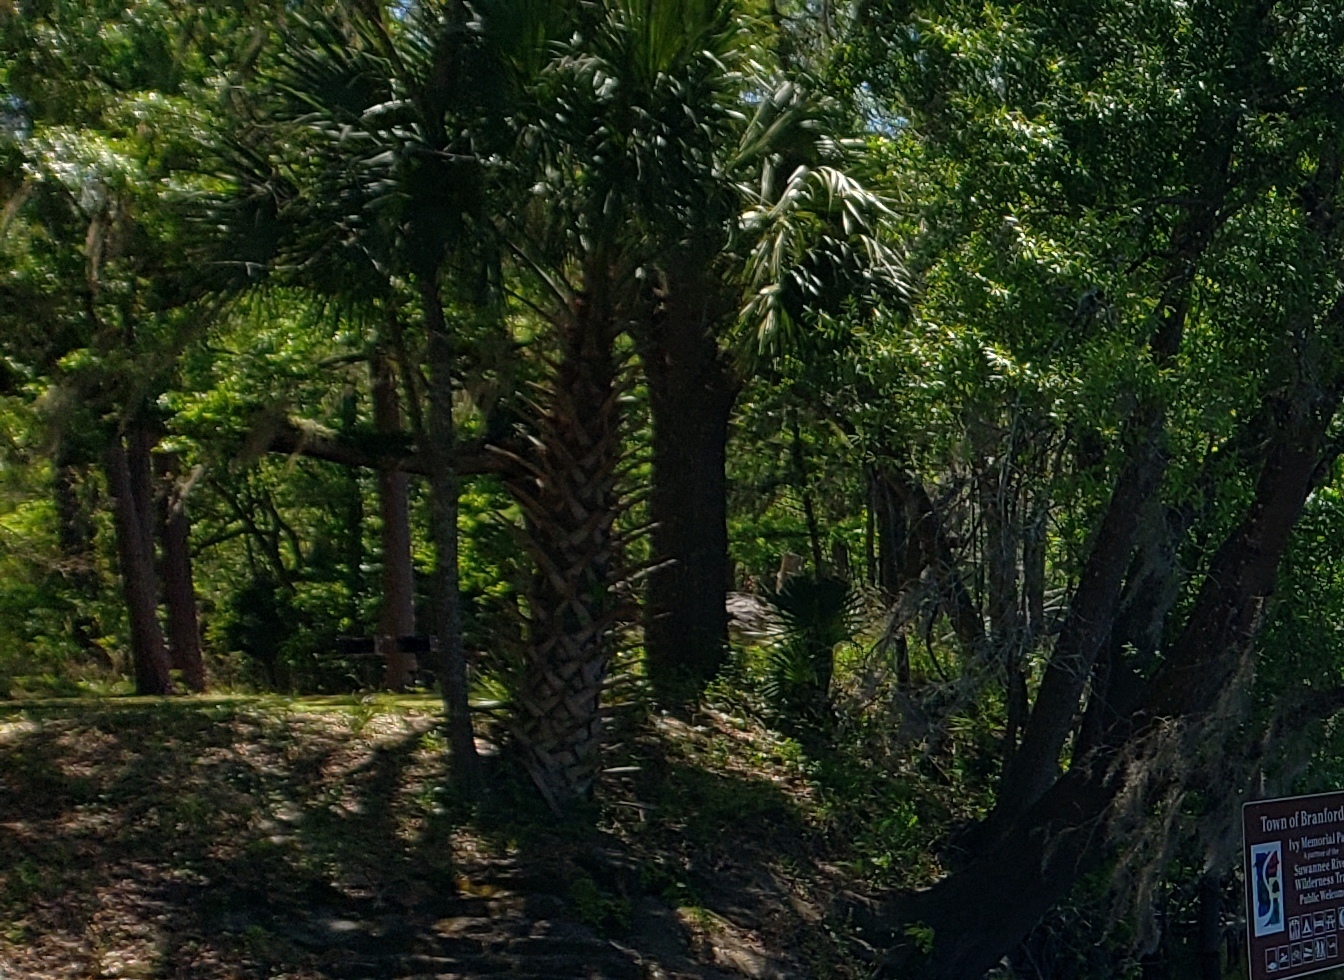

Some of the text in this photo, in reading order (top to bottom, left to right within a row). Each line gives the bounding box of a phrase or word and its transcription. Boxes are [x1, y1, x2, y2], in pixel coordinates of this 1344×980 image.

[1260, 805, 1344, 833] Town of Branford
[1289, 839, 1299, 852] Ivy
[1301, 832, 1335, 848] Memorial
[1294, 862, 1330, 876] Suwannee
[1295, 876, 1334, 890] Wilderness
[1300, 893, 1319, 905] Public
